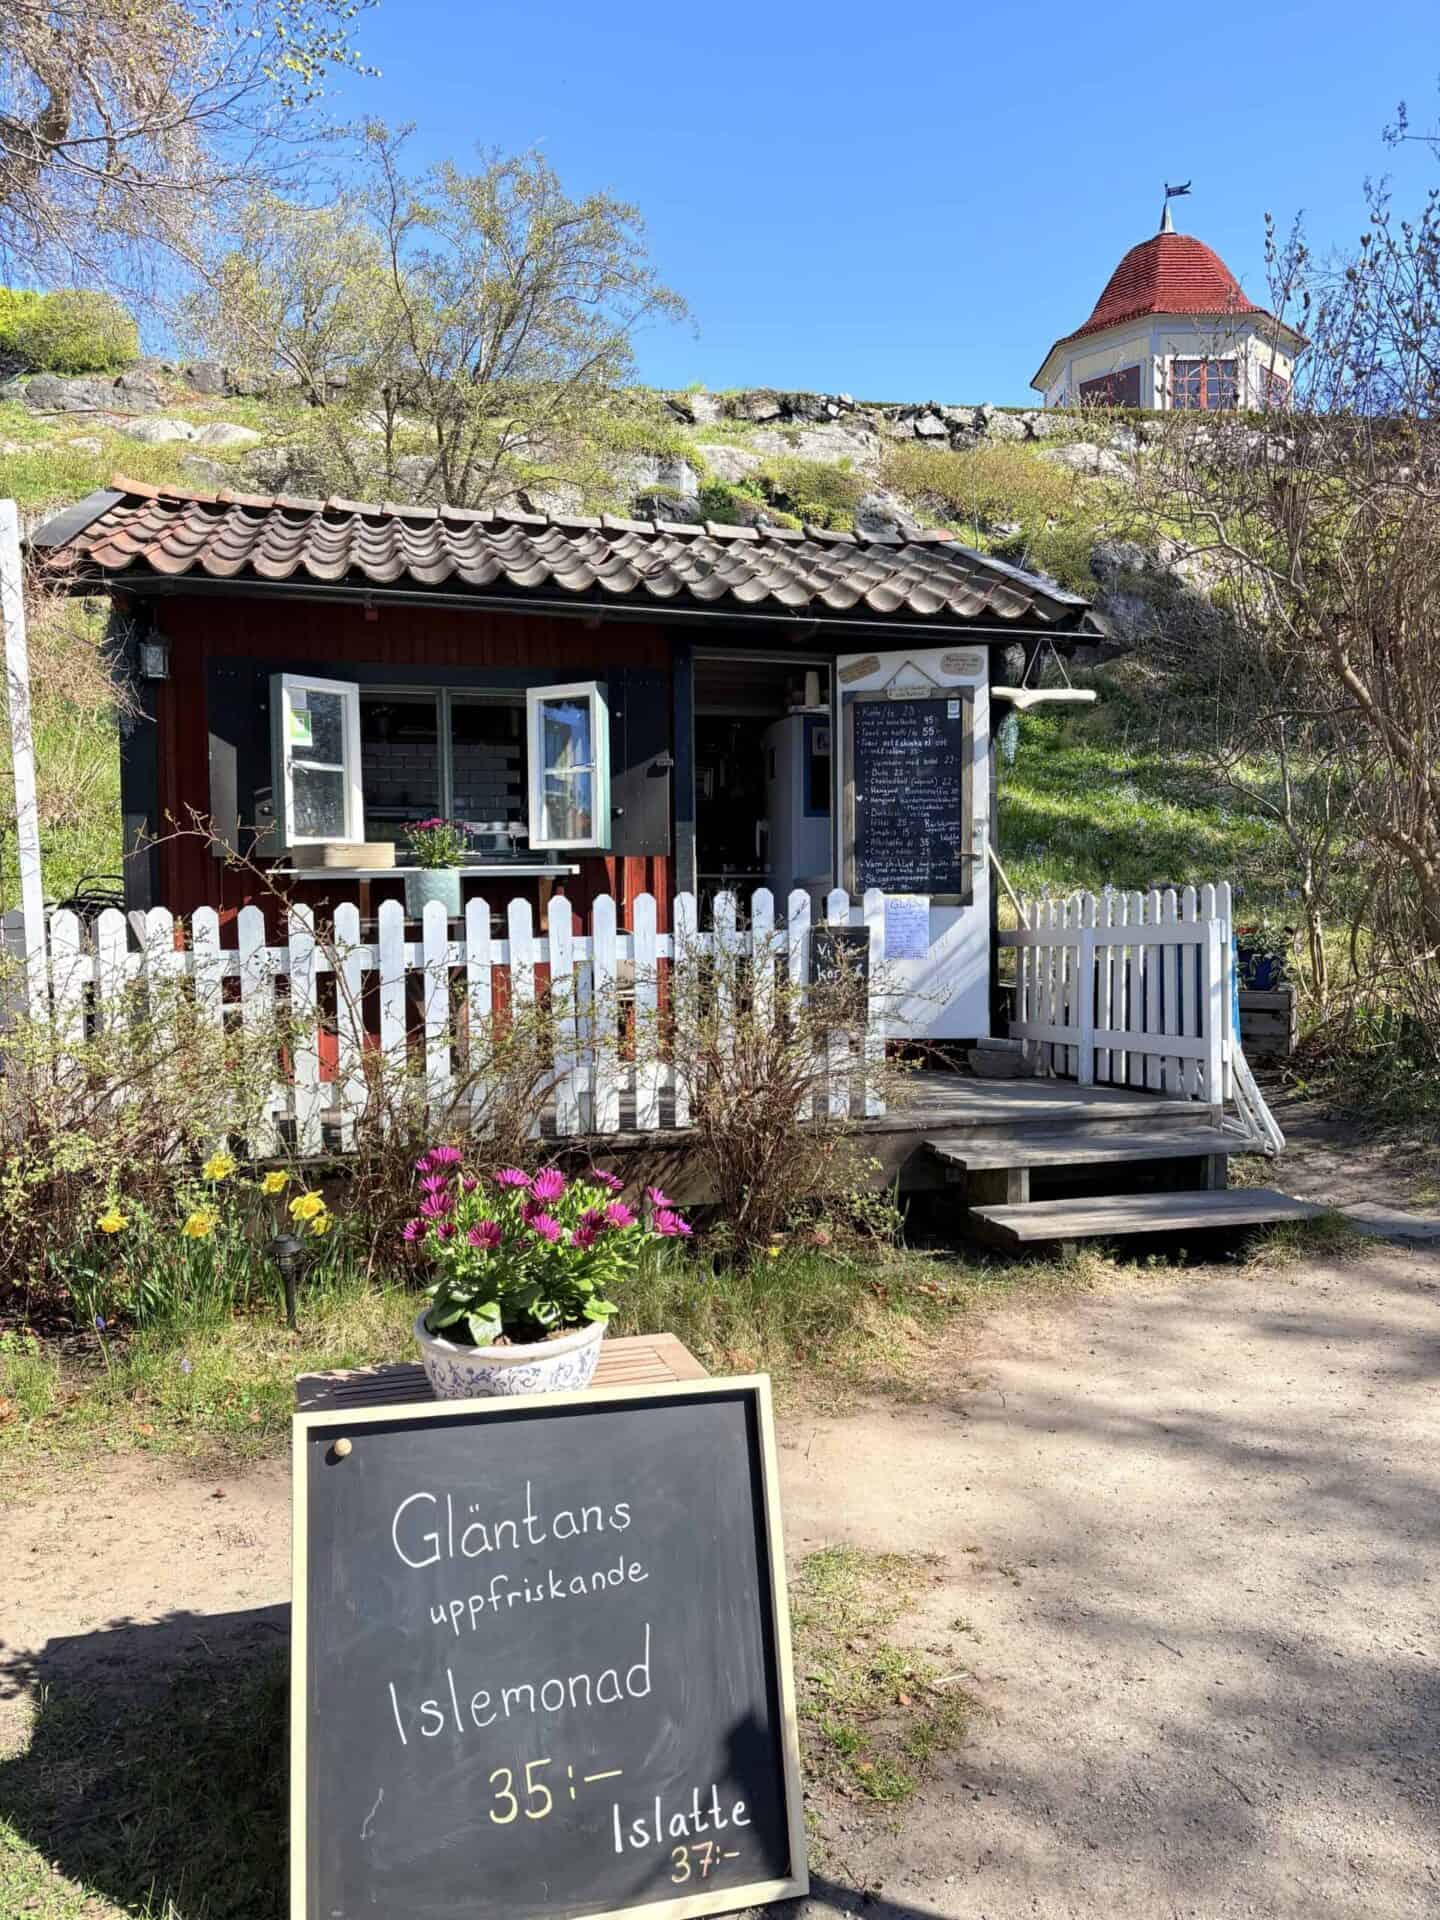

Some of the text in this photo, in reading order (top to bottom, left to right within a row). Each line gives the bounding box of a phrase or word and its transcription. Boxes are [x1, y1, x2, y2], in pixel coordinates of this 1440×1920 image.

[392, 1480, 632, 1568] Gläntans
[430, 1556, 649, 1636] uppfriskande
[389, 1623, 652, 1745] Islemonad
[488, 1758, 623, 1824] 35:-
[613, 1783, 751, 1853] Islatte
